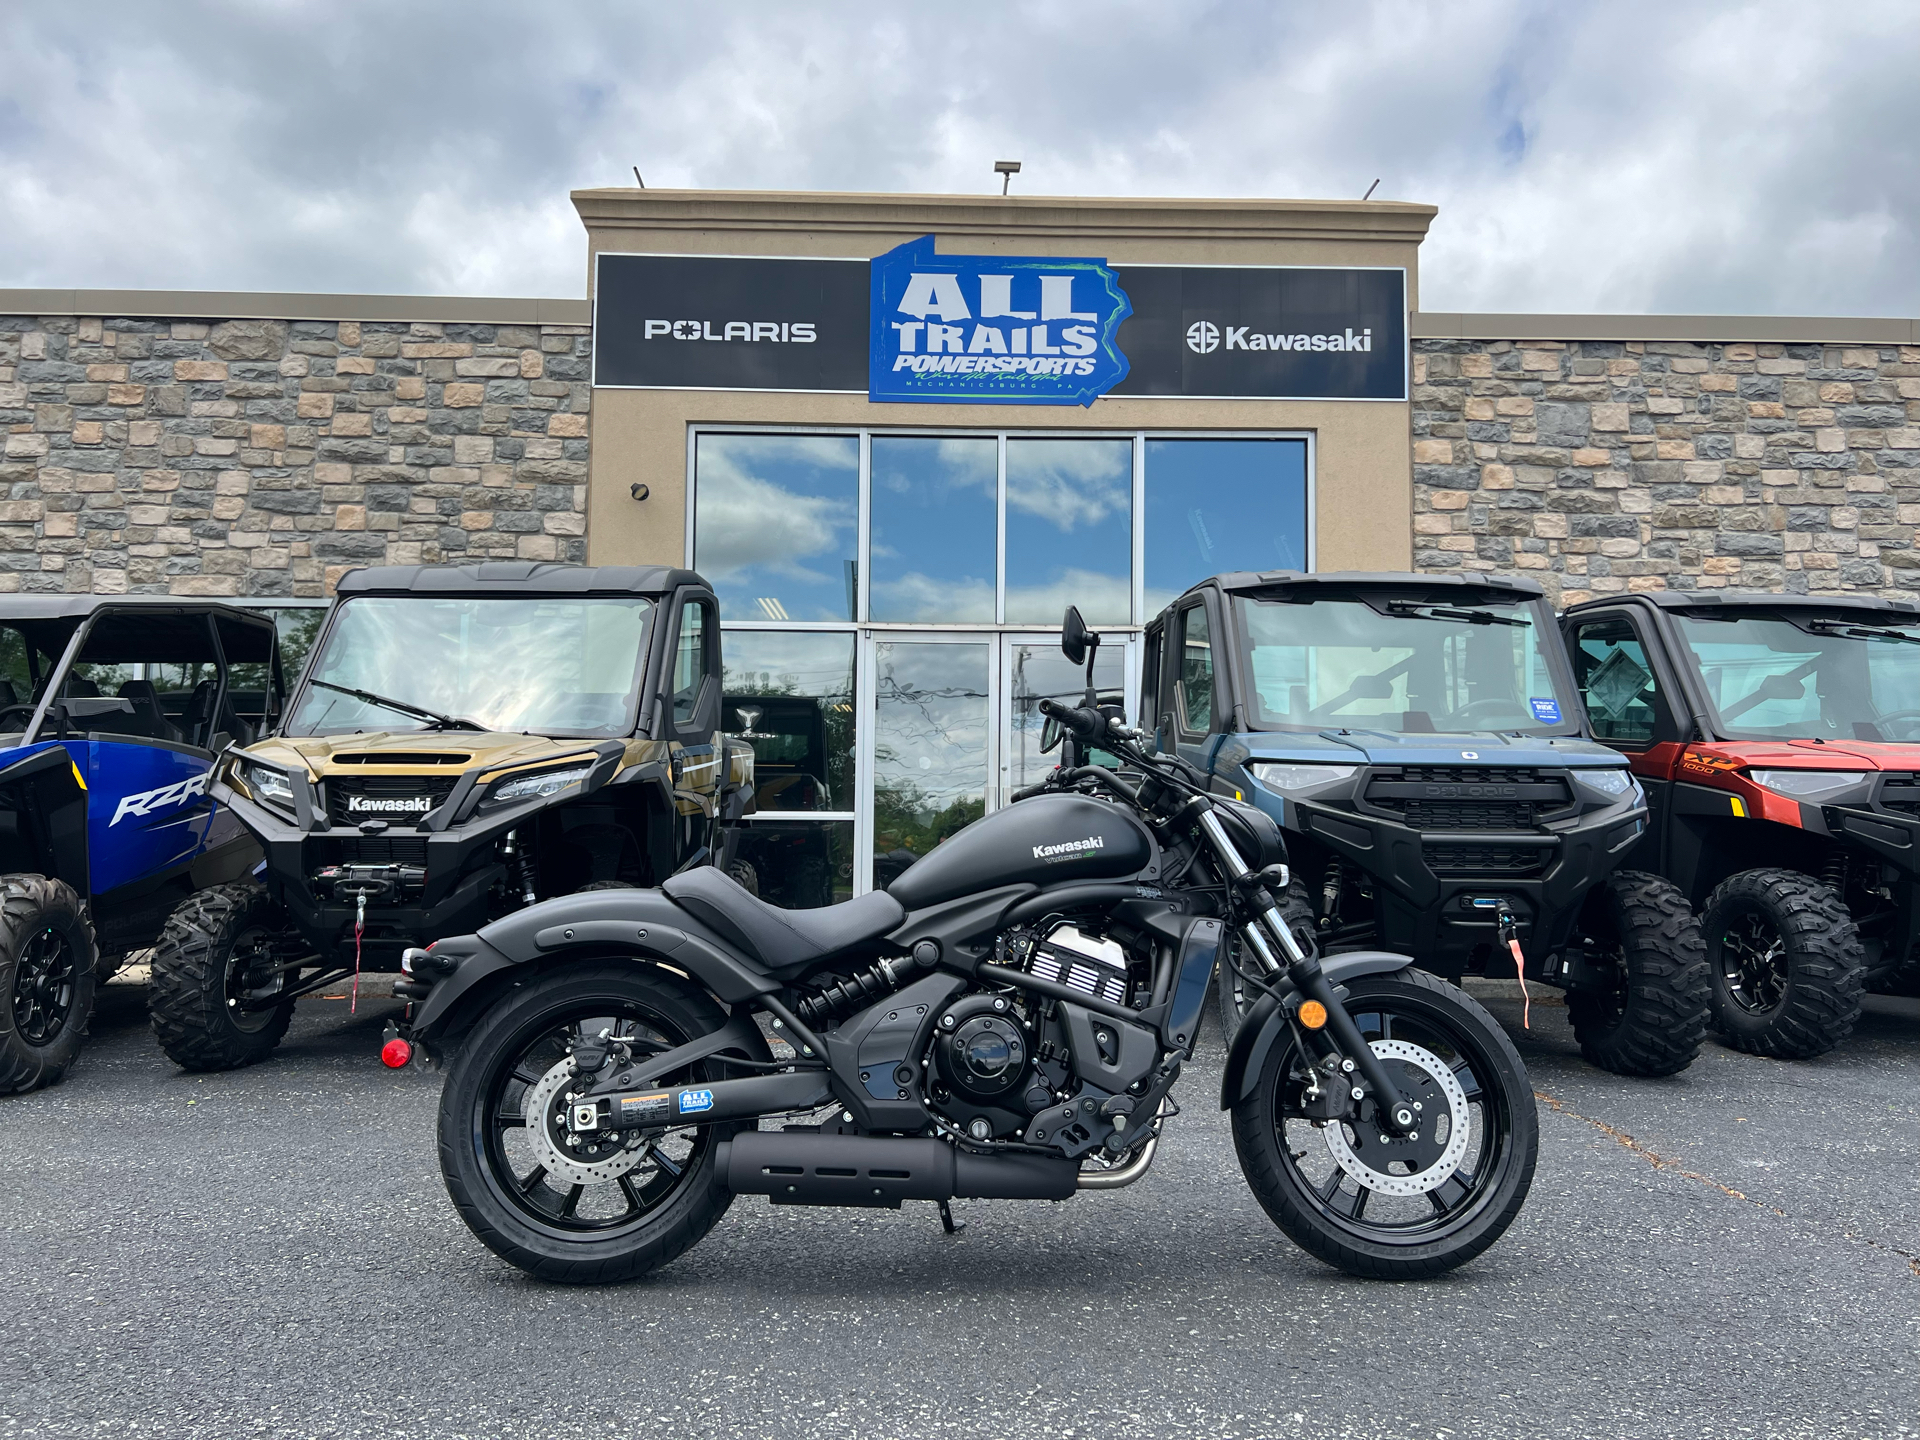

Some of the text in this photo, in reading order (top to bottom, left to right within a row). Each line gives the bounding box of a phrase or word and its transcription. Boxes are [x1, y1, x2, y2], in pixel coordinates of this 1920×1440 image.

[897, 273, 1098, 324] ALL
[645, 319, 817, 343] POLARIS
[891, 322, 1098, 356] TRAILS
[1226, 326, 1371, 352] Kawasaki
[892, 355, 1097, 376] POWERSPORTS
[1683, 762, 1715, 774] 1000
[1689, 752, 1733, 764] XP
[108, 772, 208, 828] RZR
[1425, 786, 1517, 798] POLARIS
[348, 797, 431, 811] Kawasaki
[1032, 836, 1104, 859] Kawasaki
